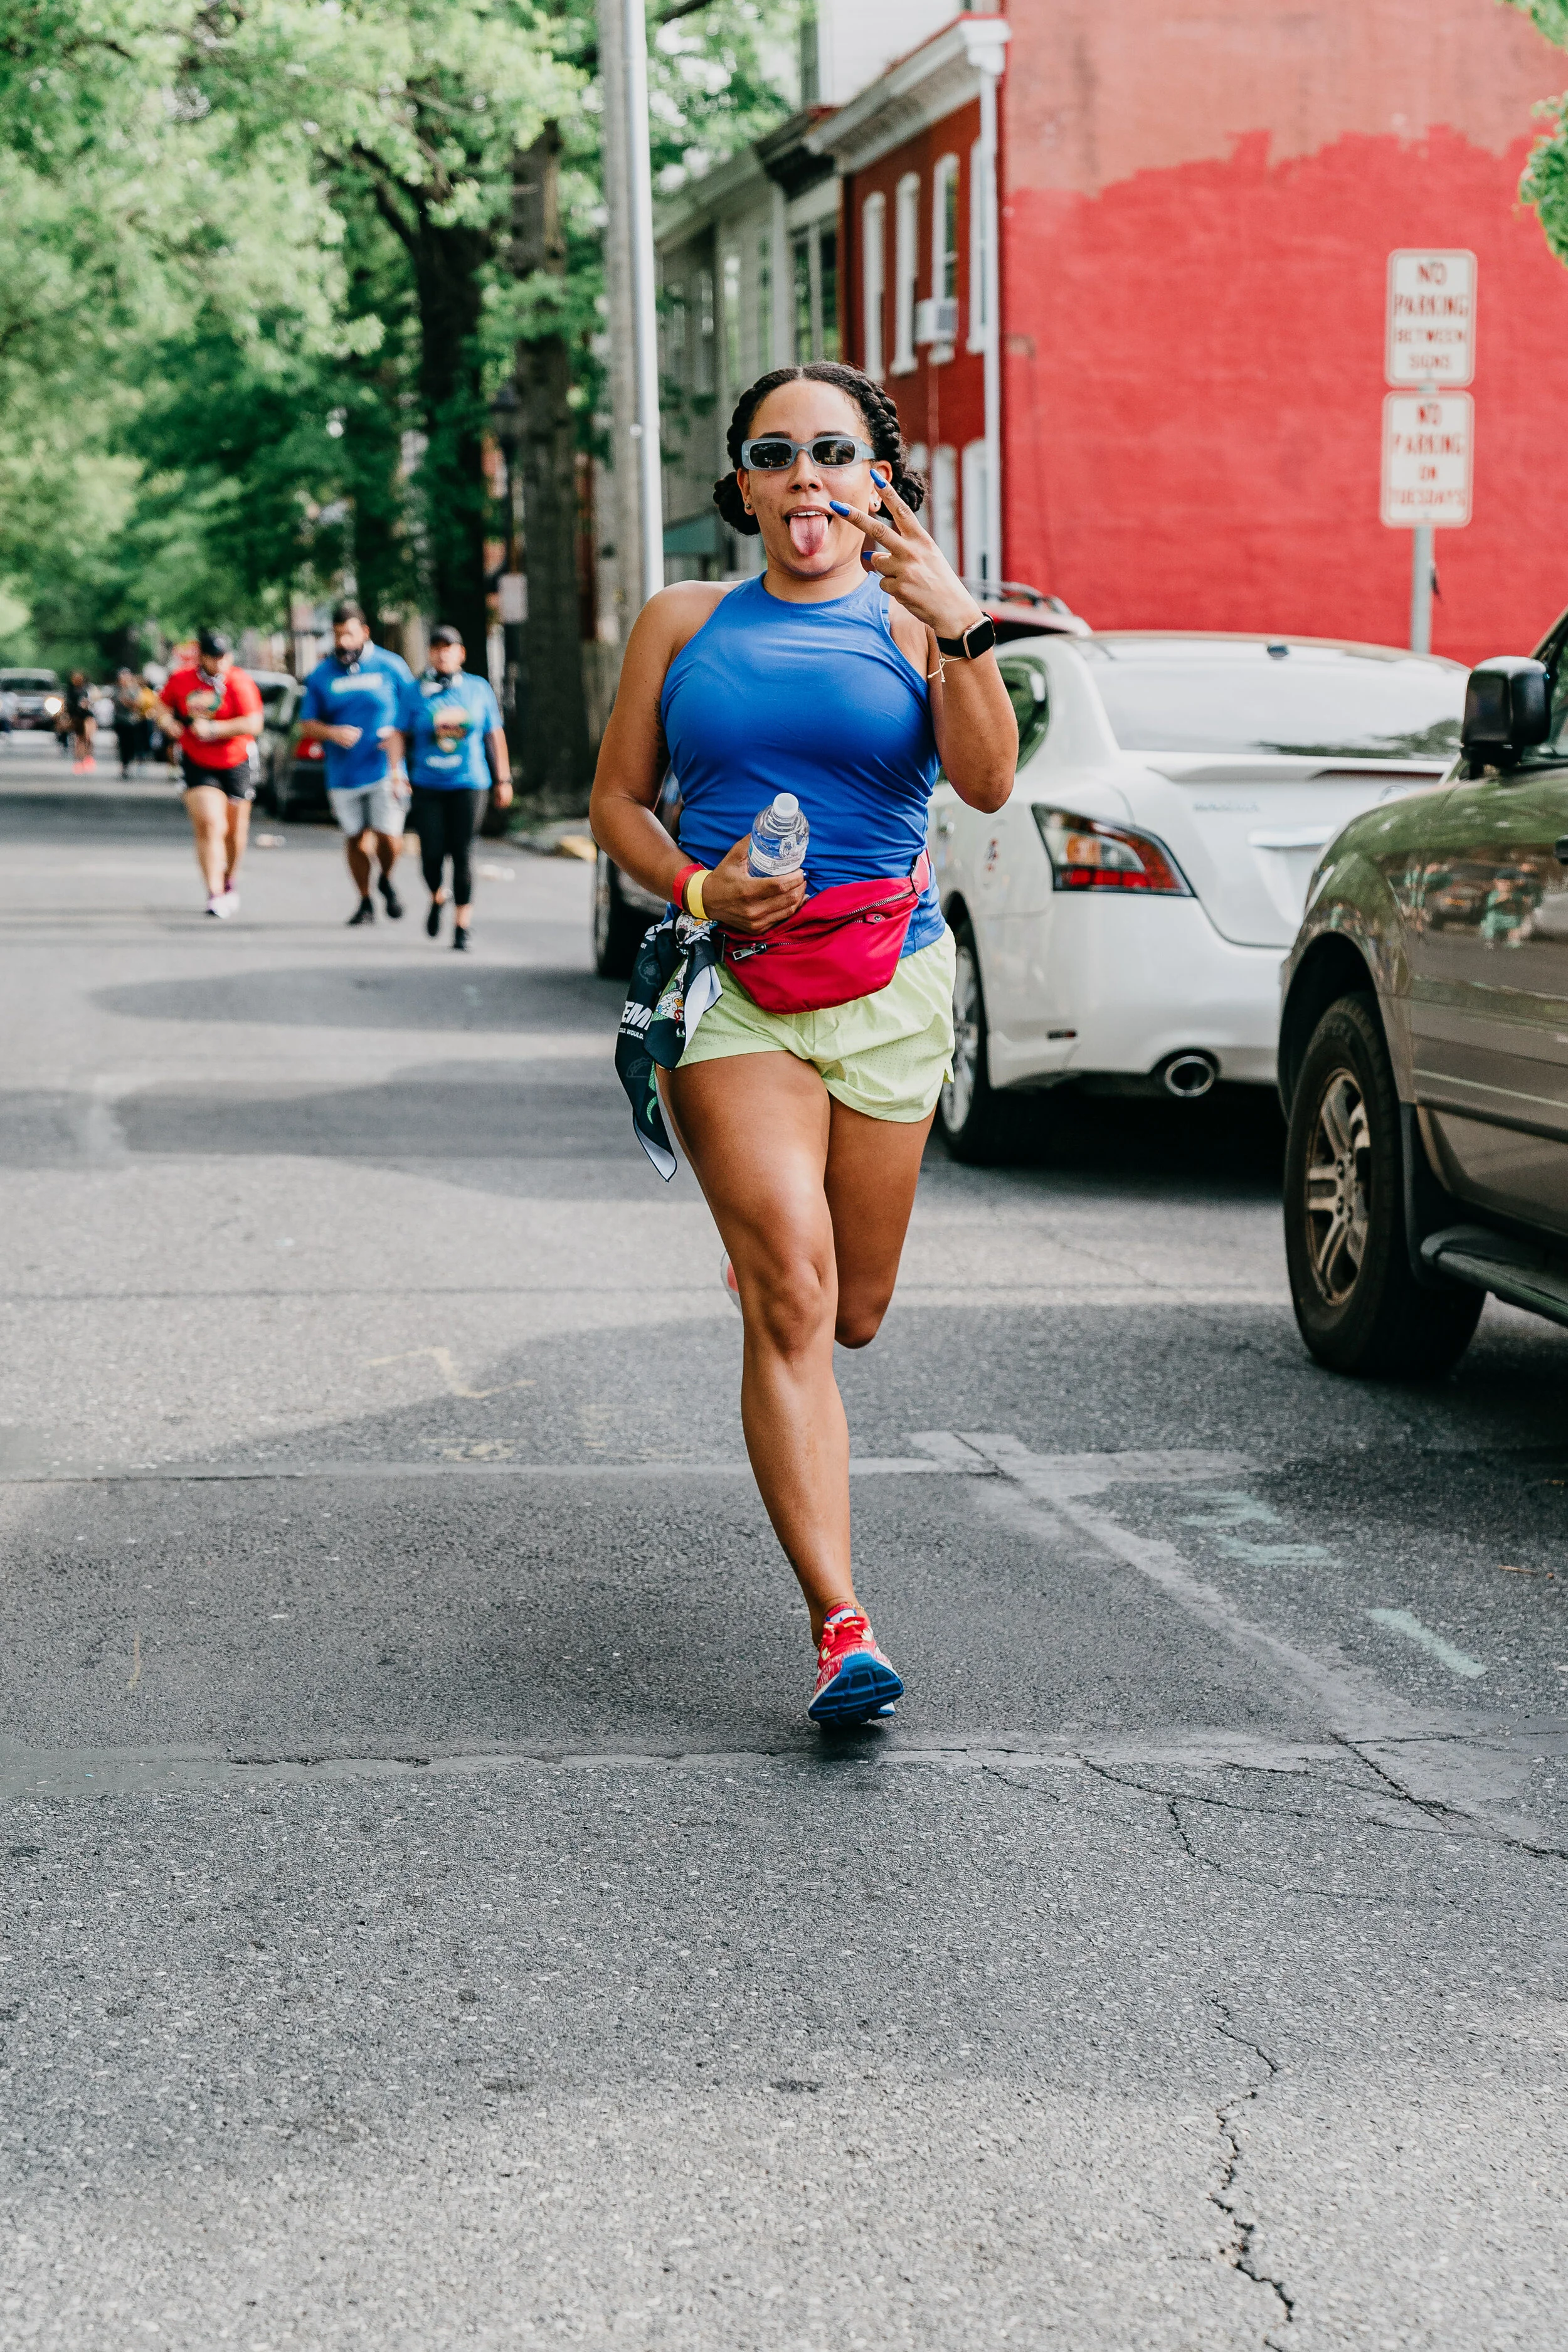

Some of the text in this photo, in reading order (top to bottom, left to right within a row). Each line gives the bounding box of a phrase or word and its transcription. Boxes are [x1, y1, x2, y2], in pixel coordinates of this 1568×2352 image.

[1417, 262, 1448, 285] NO
[1394, 294, 1469, 317] PARKING
[1417, 403, 1442, 425] NO
[1391, 432, 1465, 455] PARKING
[627, 1029, 644, 1040] WOULD.
